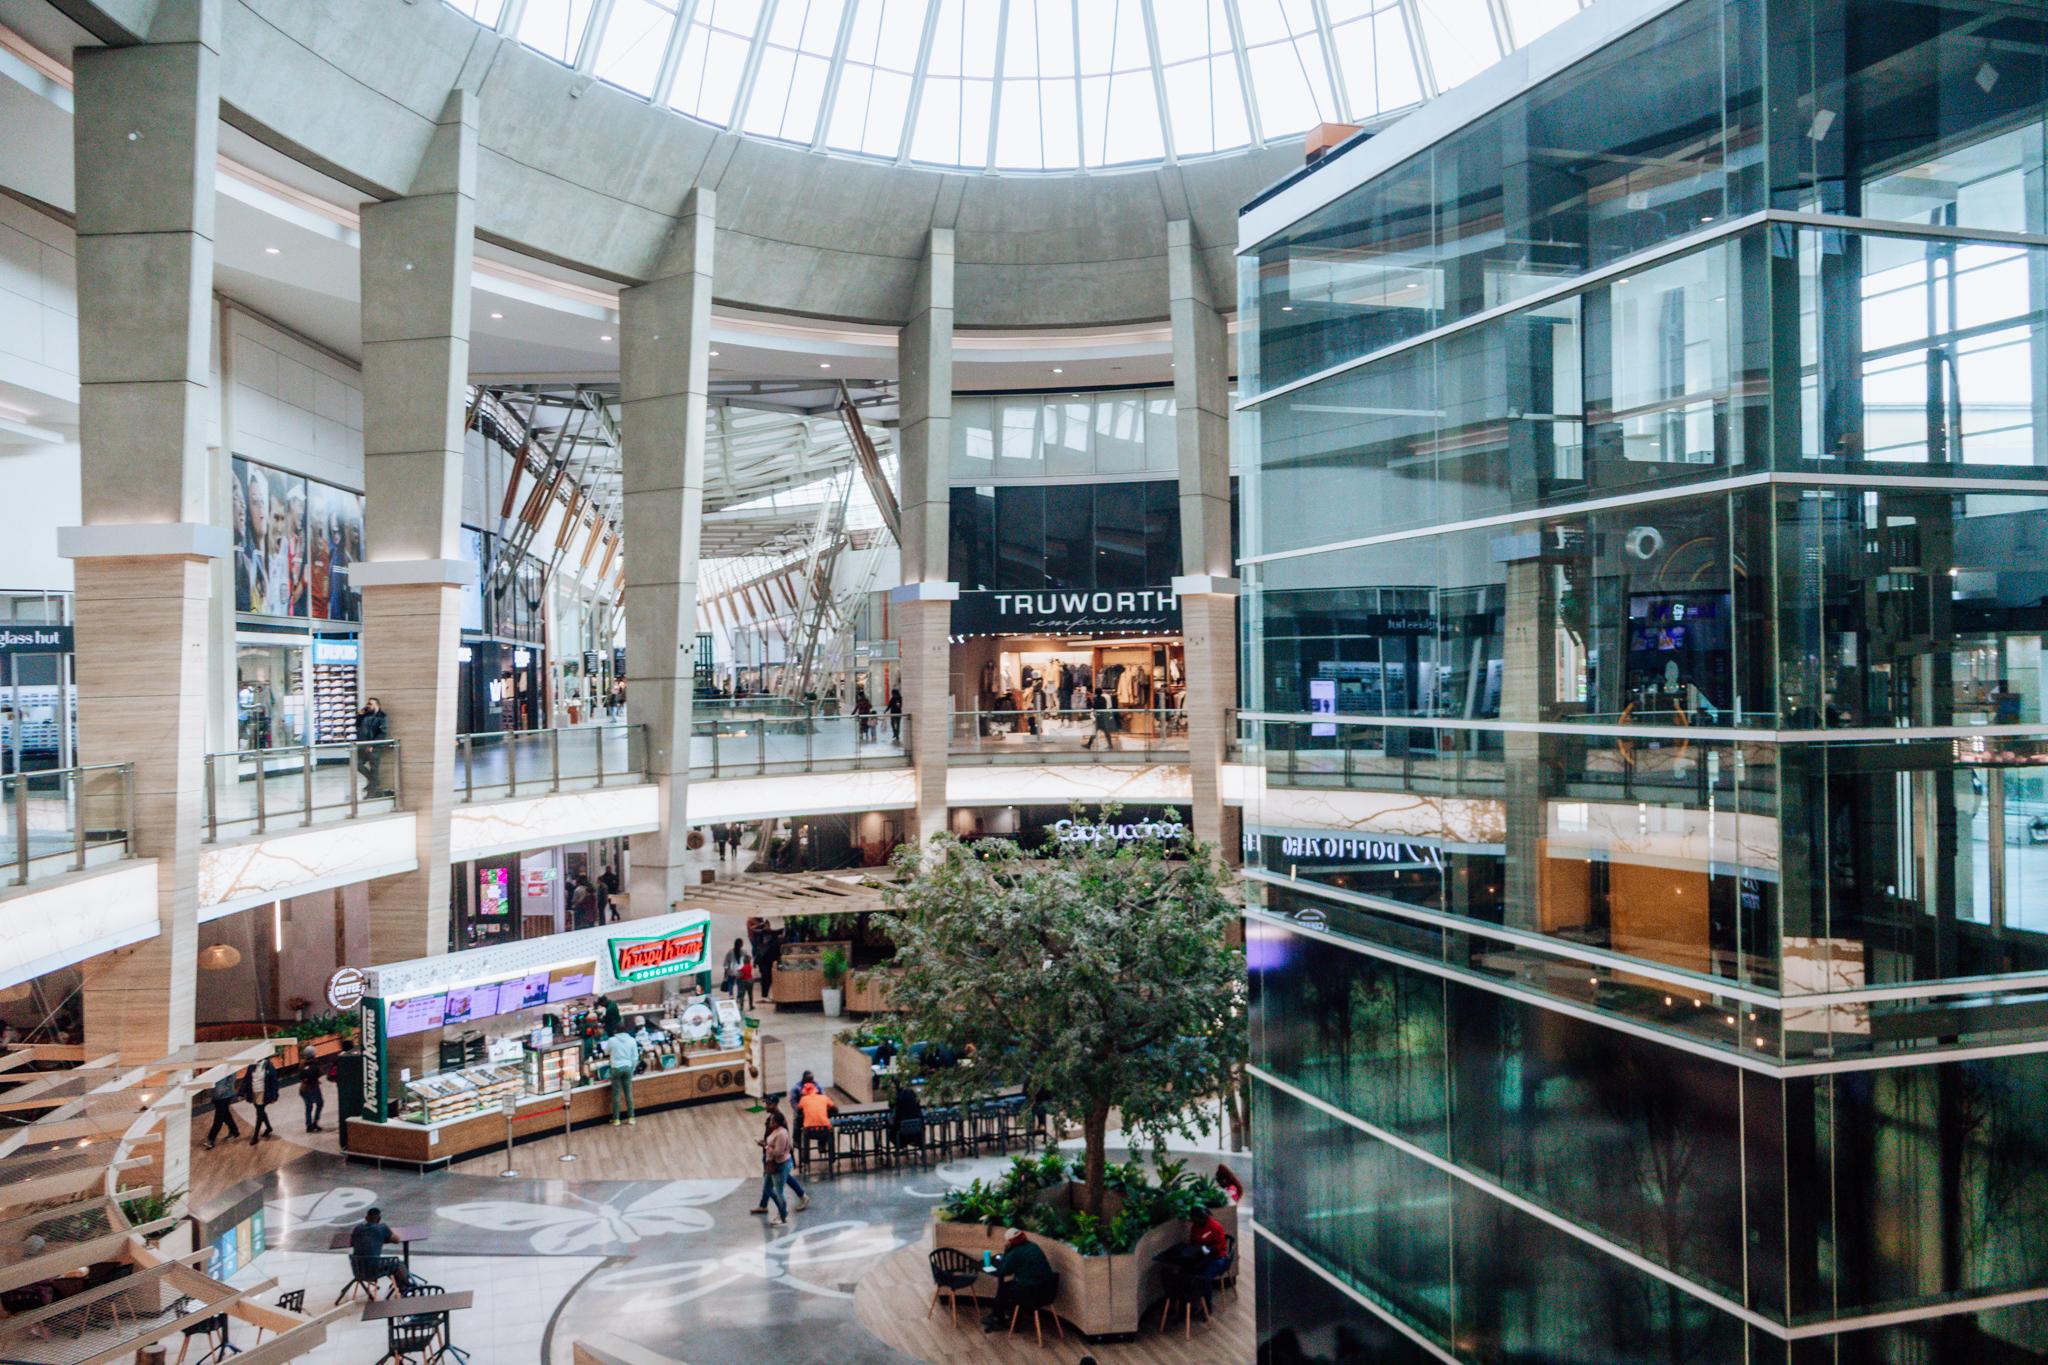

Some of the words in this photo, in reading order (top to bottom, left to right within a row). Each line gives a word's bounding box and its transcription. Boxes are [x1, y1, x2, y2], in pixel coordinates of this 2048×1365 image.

[994, 592, 1178, 615] TRUWORTH
[1029, 616, 1168, 632] emporium
[34, 630, 60, 645] hut
[619, 940, 666, 972] Krispy
[663, 931, 705, 961] Kreme
[636, 962, 690, 980] DOUGHNUTS
[362, 1005, 377, 1061] Kreme
[363, 1056, 380, 1113] Krispy
